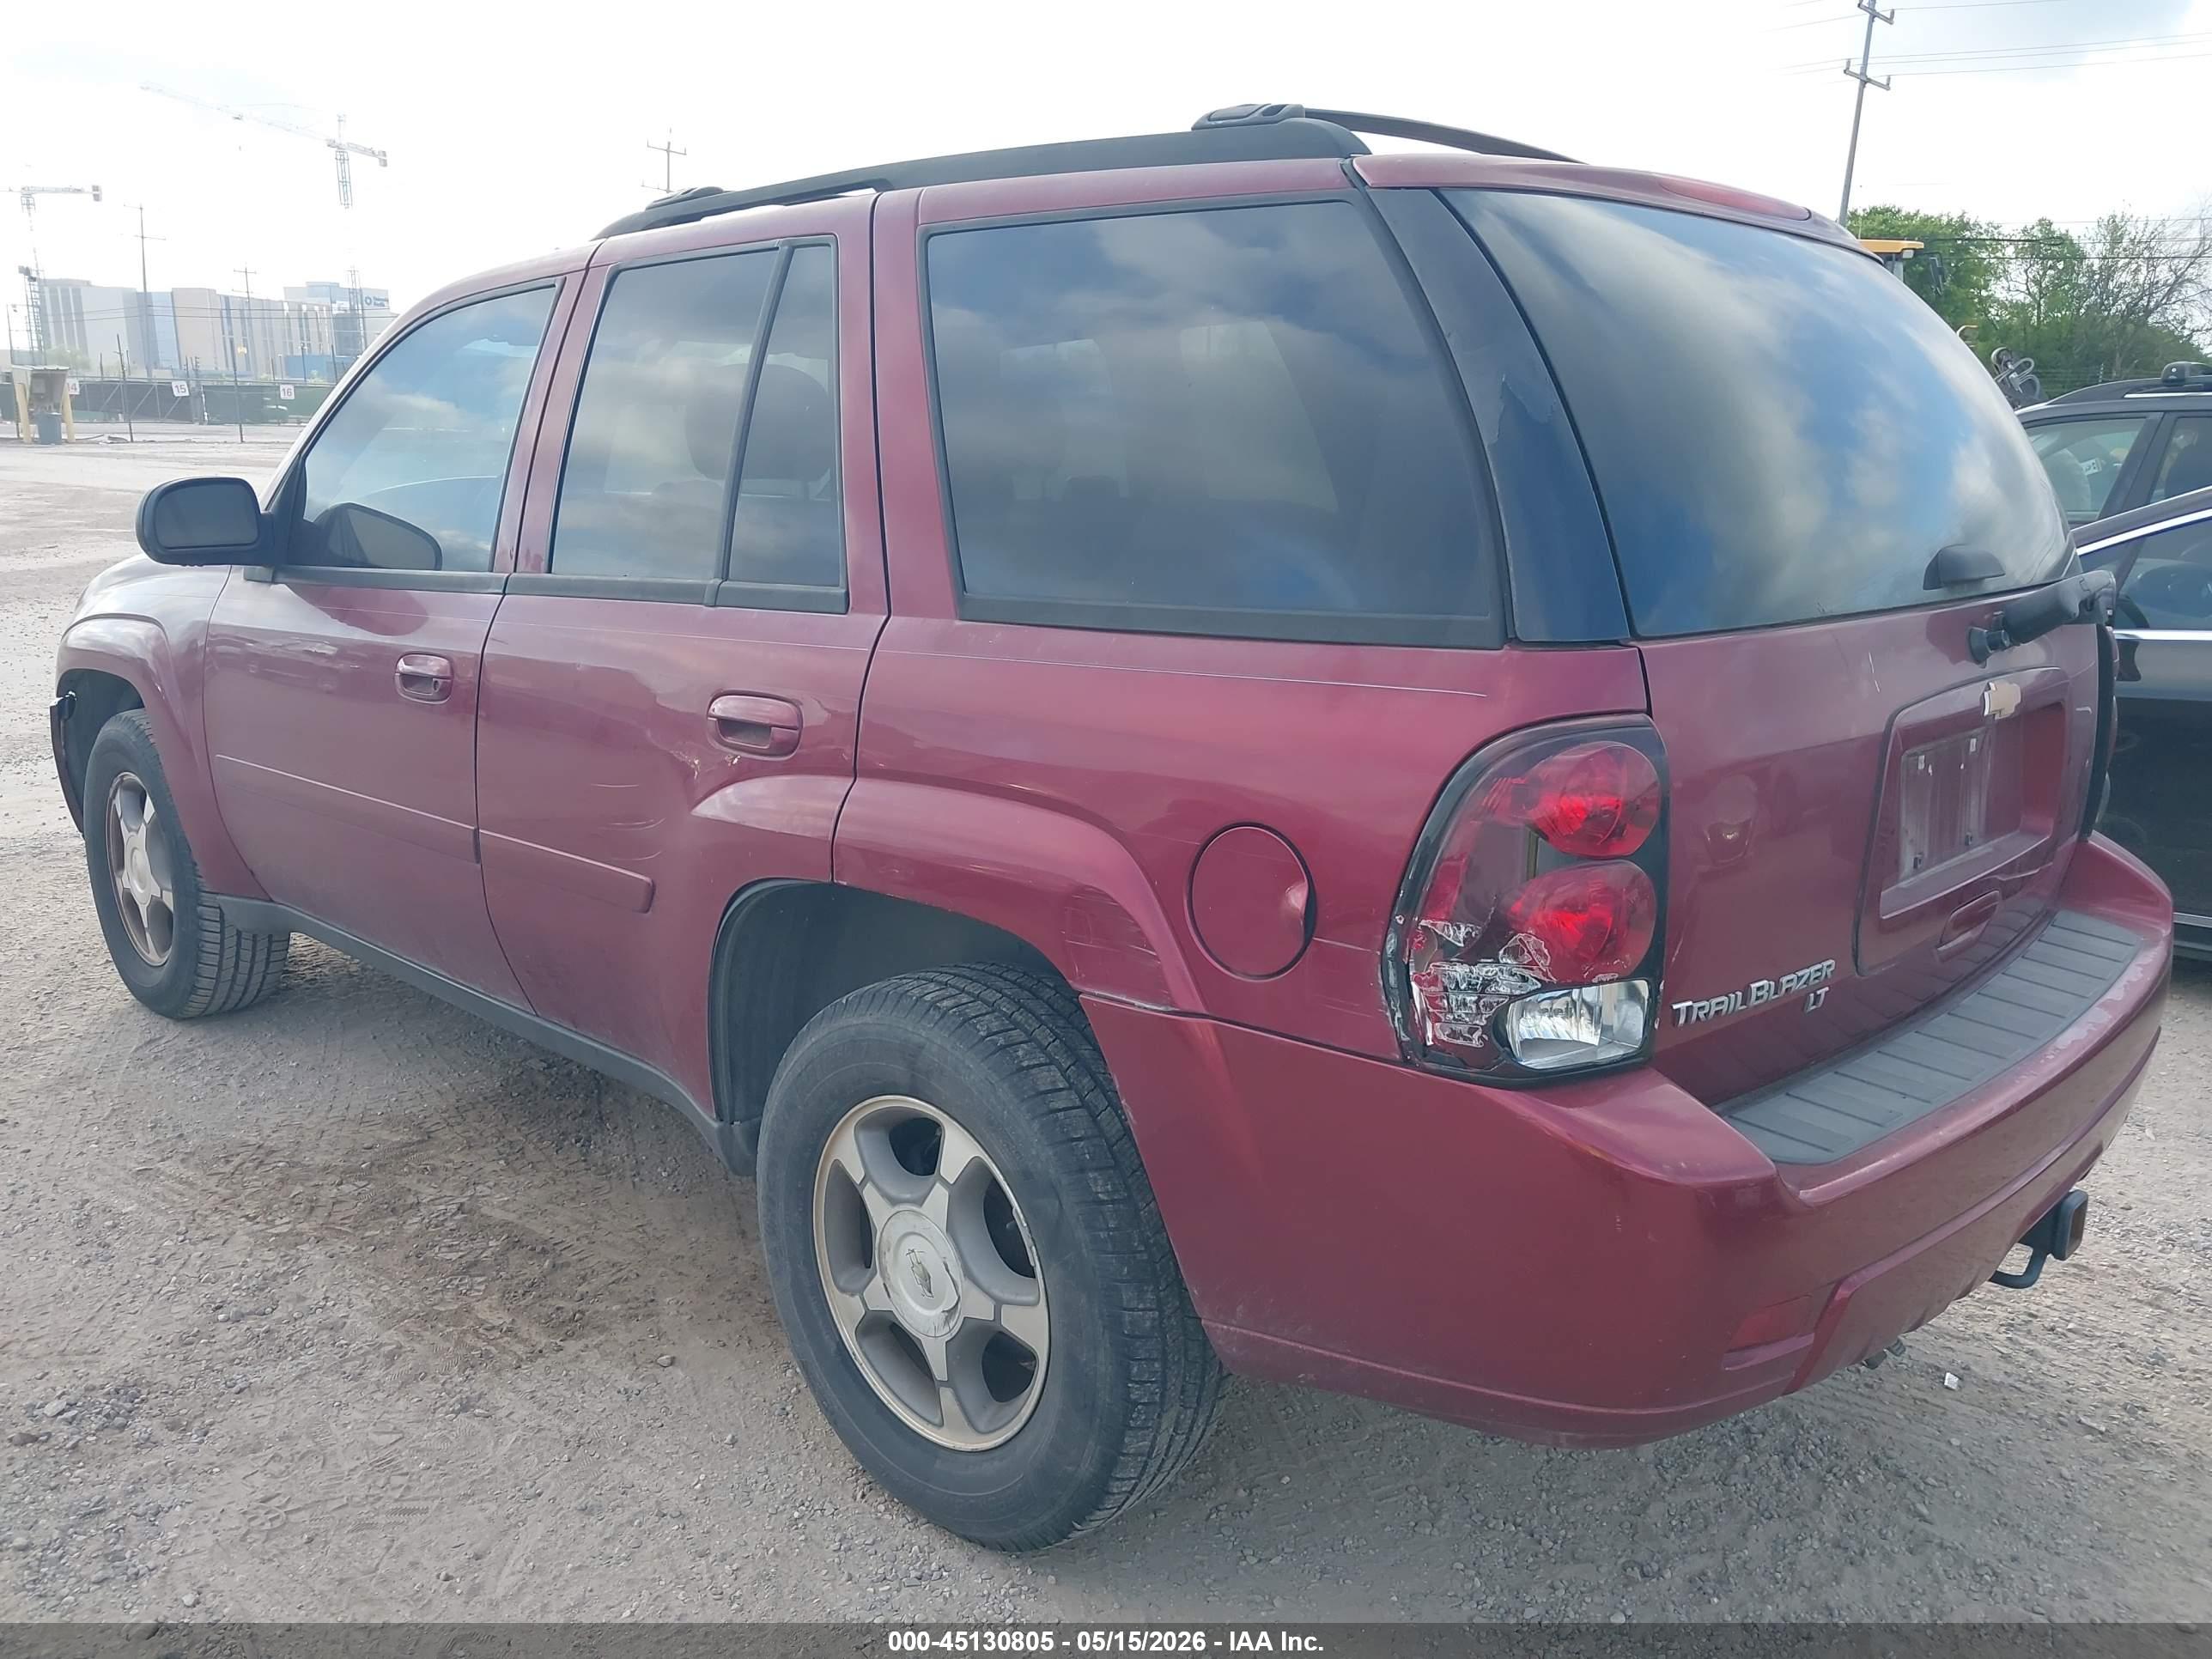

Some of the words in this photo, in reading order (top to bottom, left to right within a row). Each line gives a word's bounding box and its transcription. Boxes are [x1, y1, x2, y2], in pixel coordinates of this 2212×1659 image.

[174, 384, 186, 393] 15
[282, 388, 293, 398] 16
[1807, 987, 1830, 1012] LT
